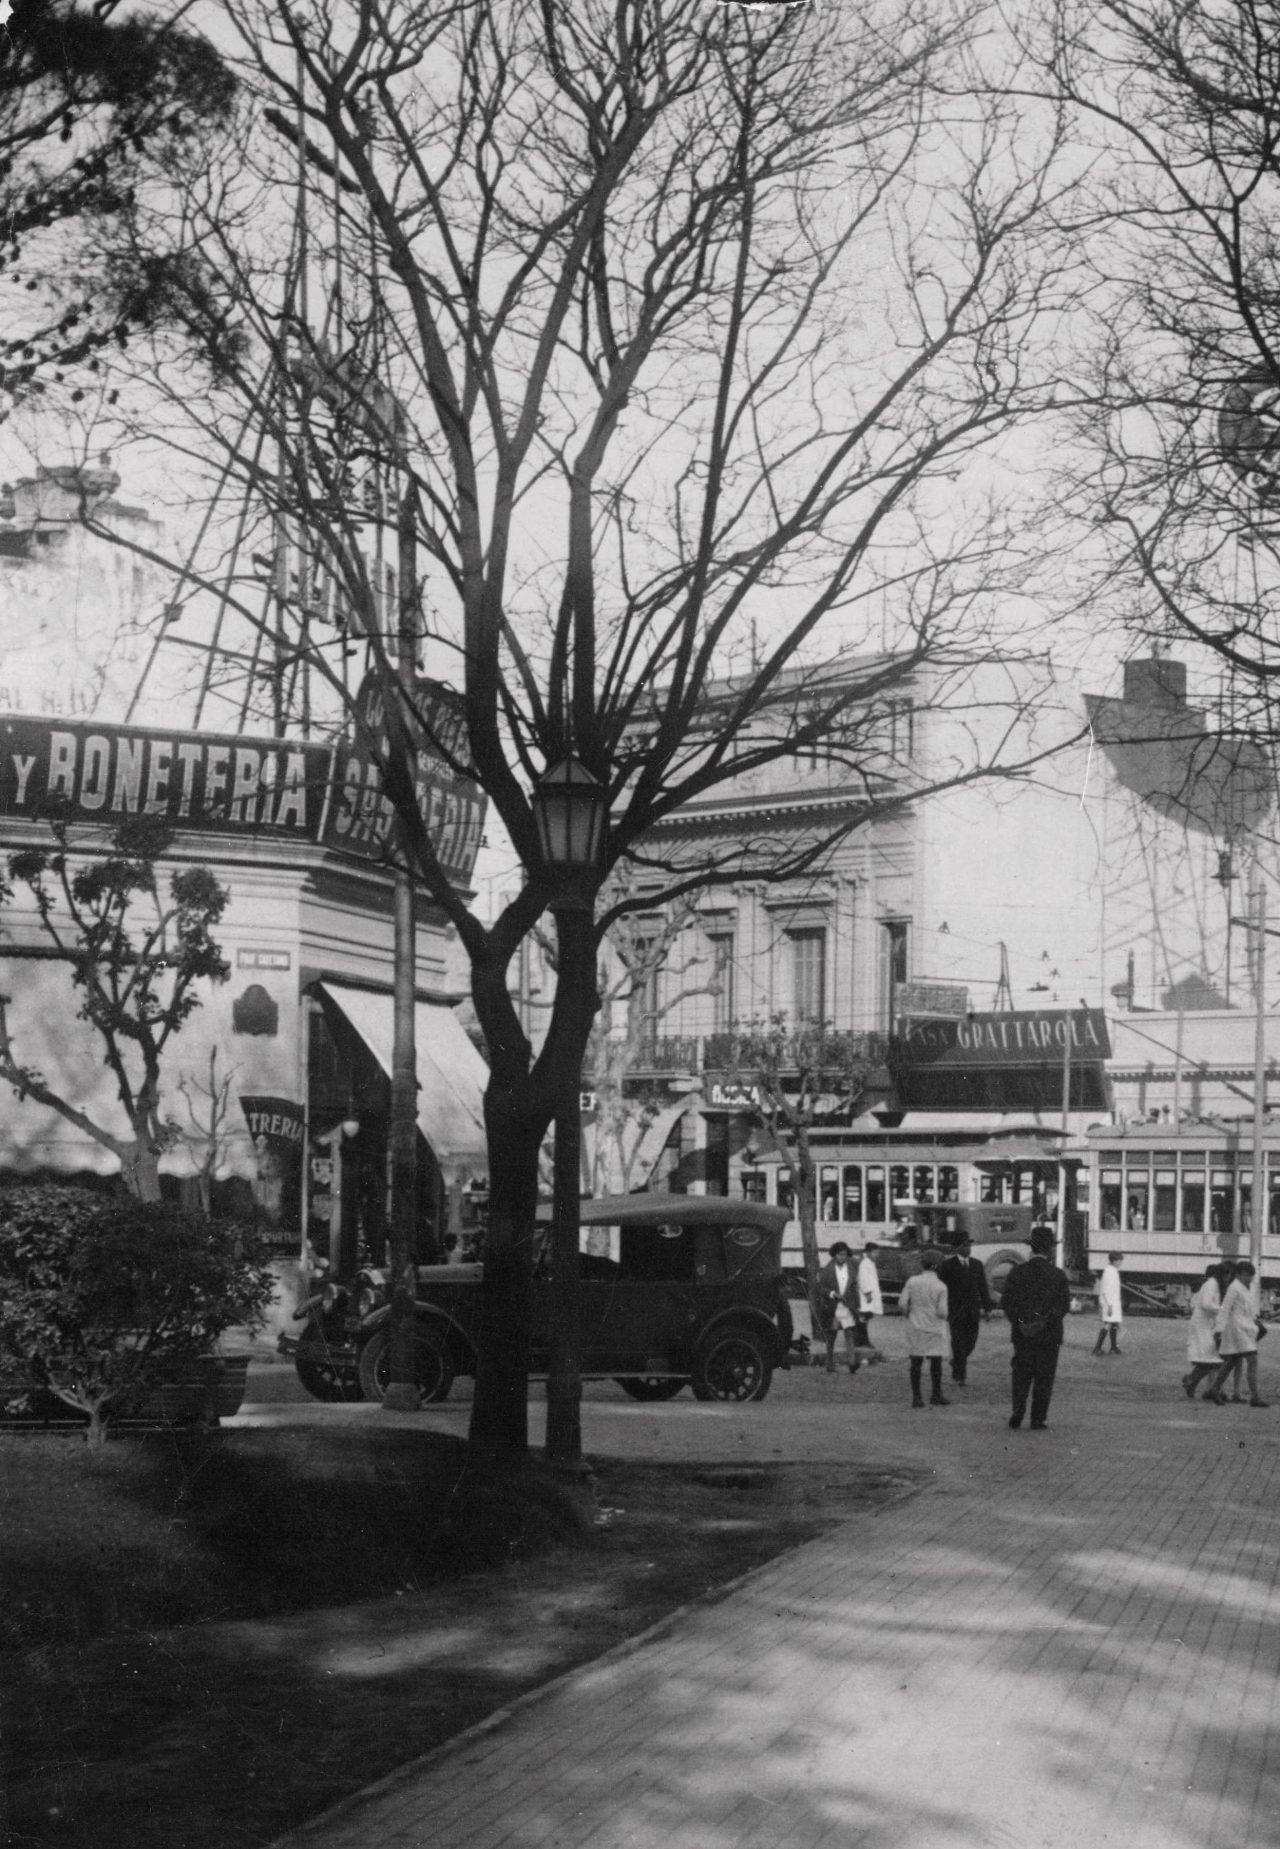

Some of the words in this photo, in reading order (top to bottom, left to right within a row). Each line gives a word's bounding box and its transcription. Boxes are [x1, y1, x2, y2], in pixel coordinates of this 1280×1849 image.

[12, 754, 37, 804] Y
[49, 731, 306, 827] BONETERIA
[957, 1019, 1099, 1049] GRATTAROLA
